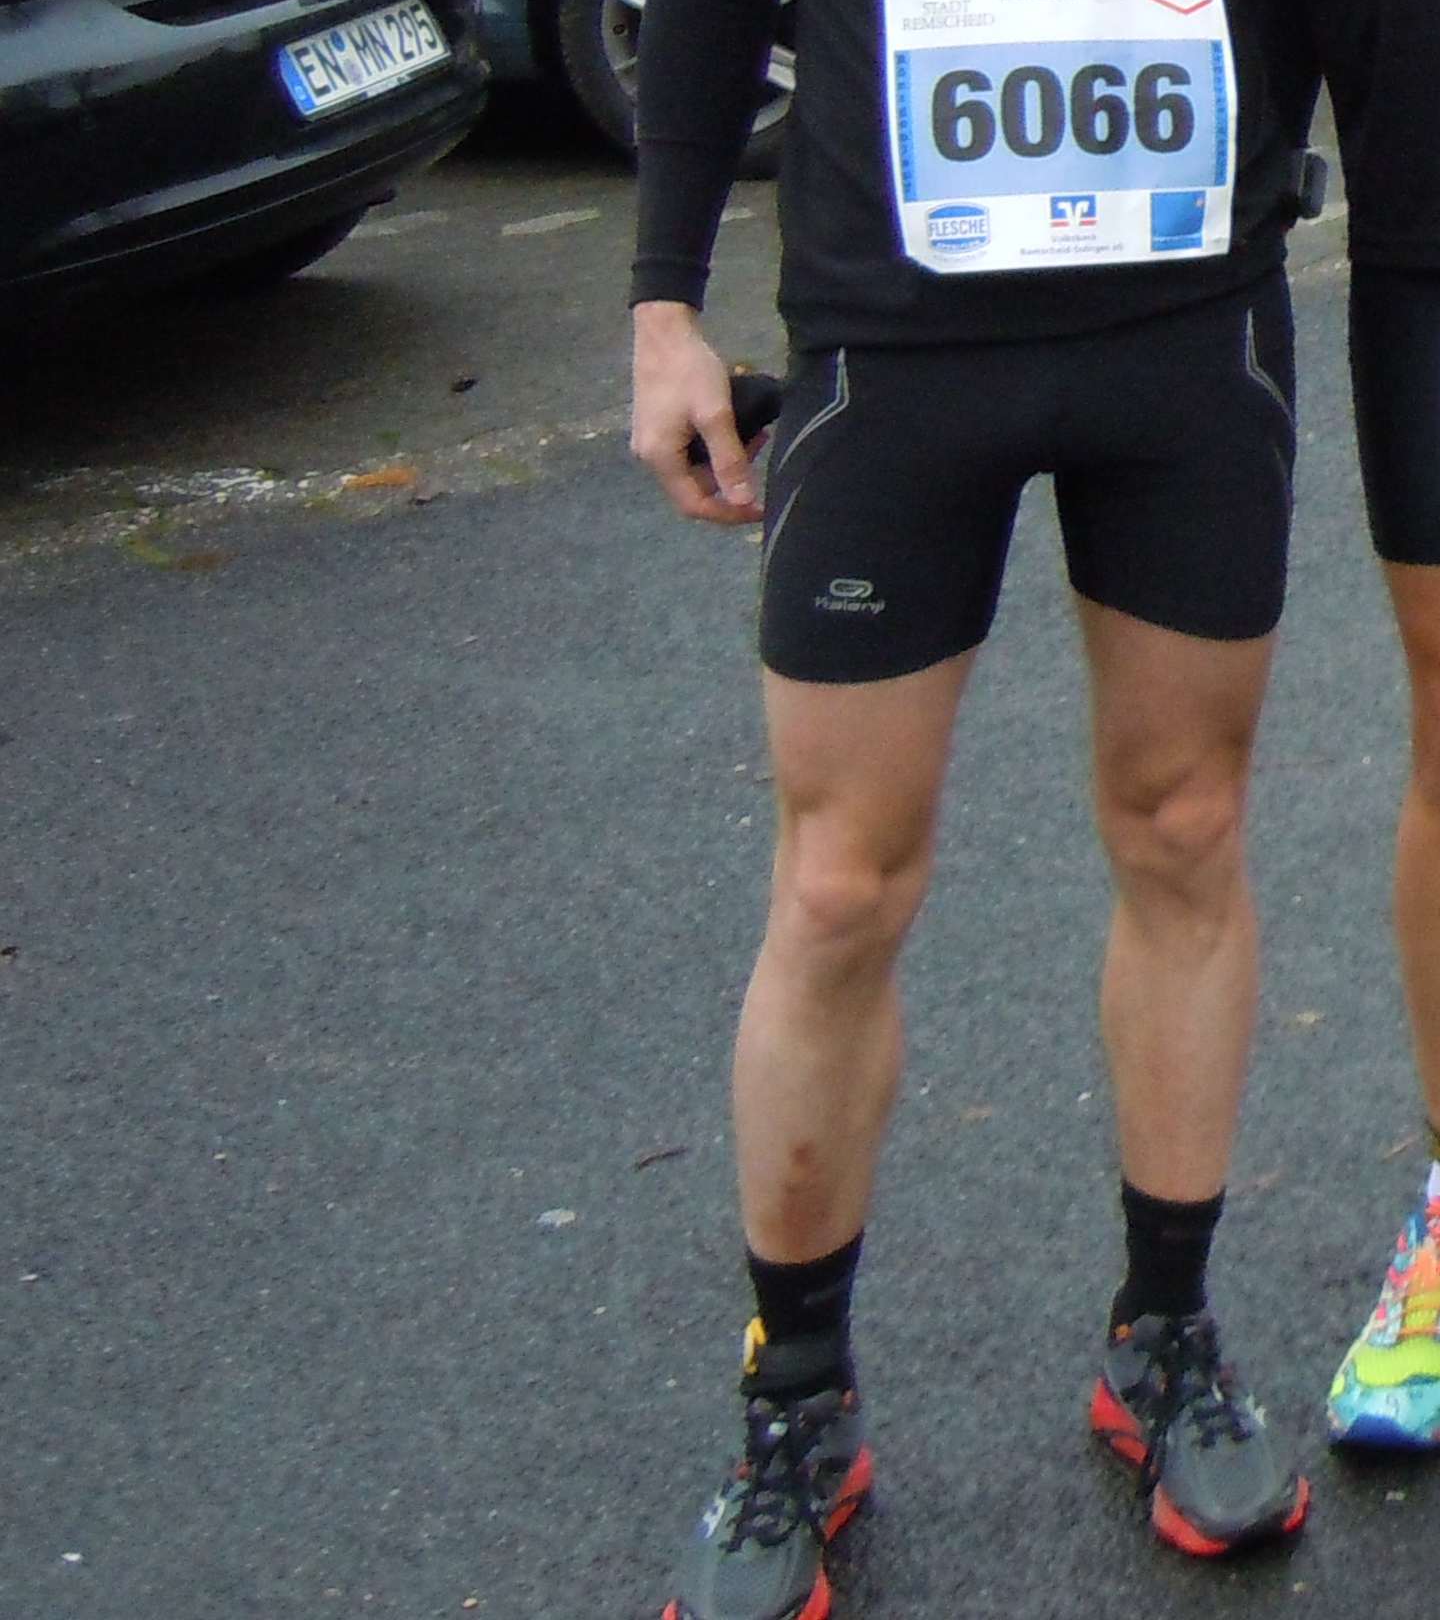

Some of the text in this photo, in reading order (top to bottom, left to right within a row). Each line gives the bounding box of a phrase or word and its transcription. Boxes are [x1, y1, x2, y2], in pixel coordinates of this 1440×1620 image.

[922, 0, 972, 15] STADT
[902, 13, 996, 31] REMSCHEID
[932, 62, 1196, 162] 6066
[928, 218, 986, 238] FLESCHE
